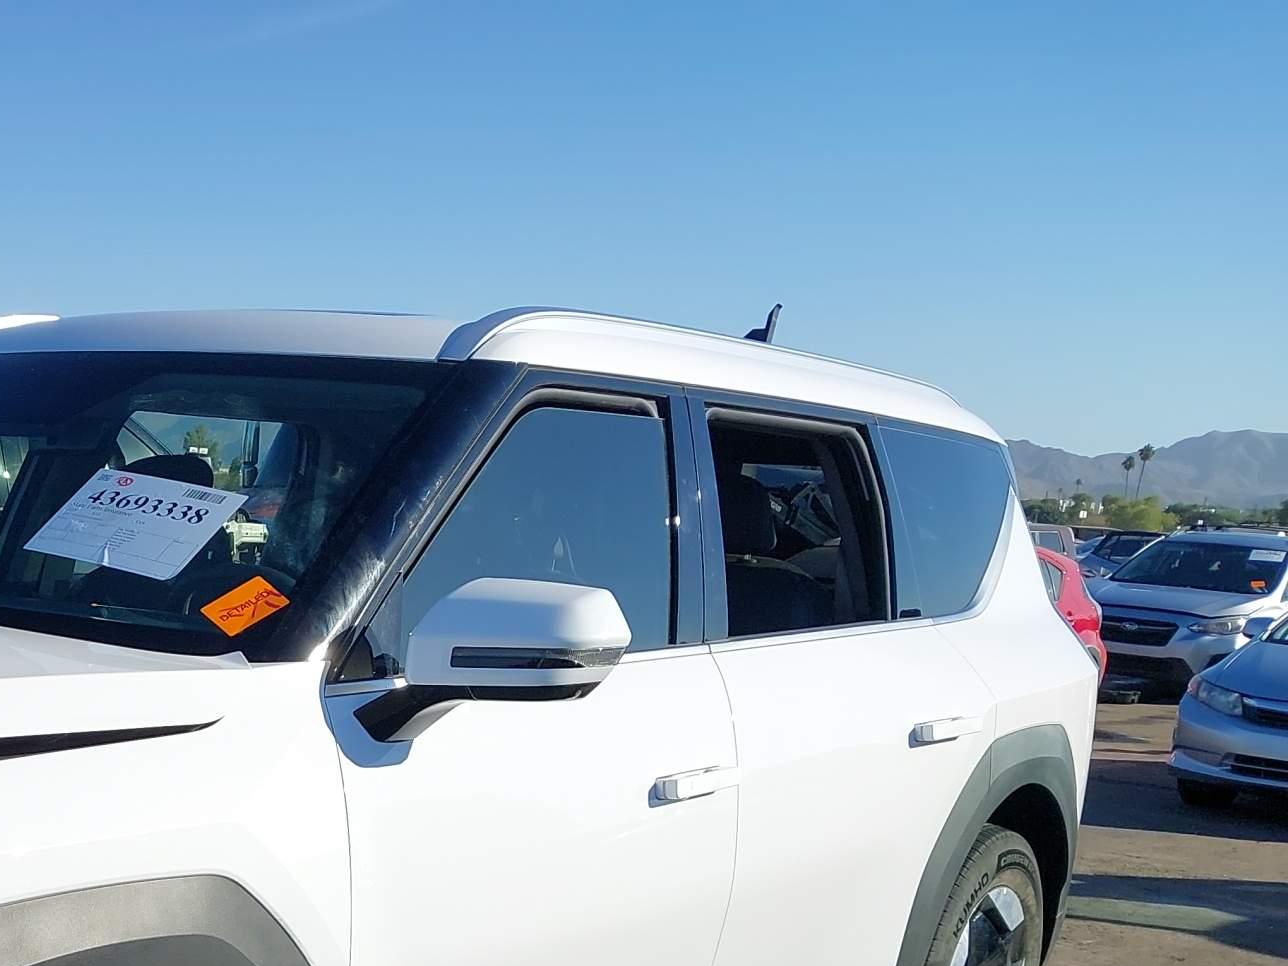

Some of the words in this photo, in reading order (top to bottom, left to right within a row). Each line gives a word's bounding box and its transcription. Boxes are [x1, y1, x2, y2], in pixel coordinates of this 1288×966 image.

[87, 488, 210, 526] 43693338
[218, 589, 271, 622] DETAILED
[952, 872, 990, 939] KUMHO
